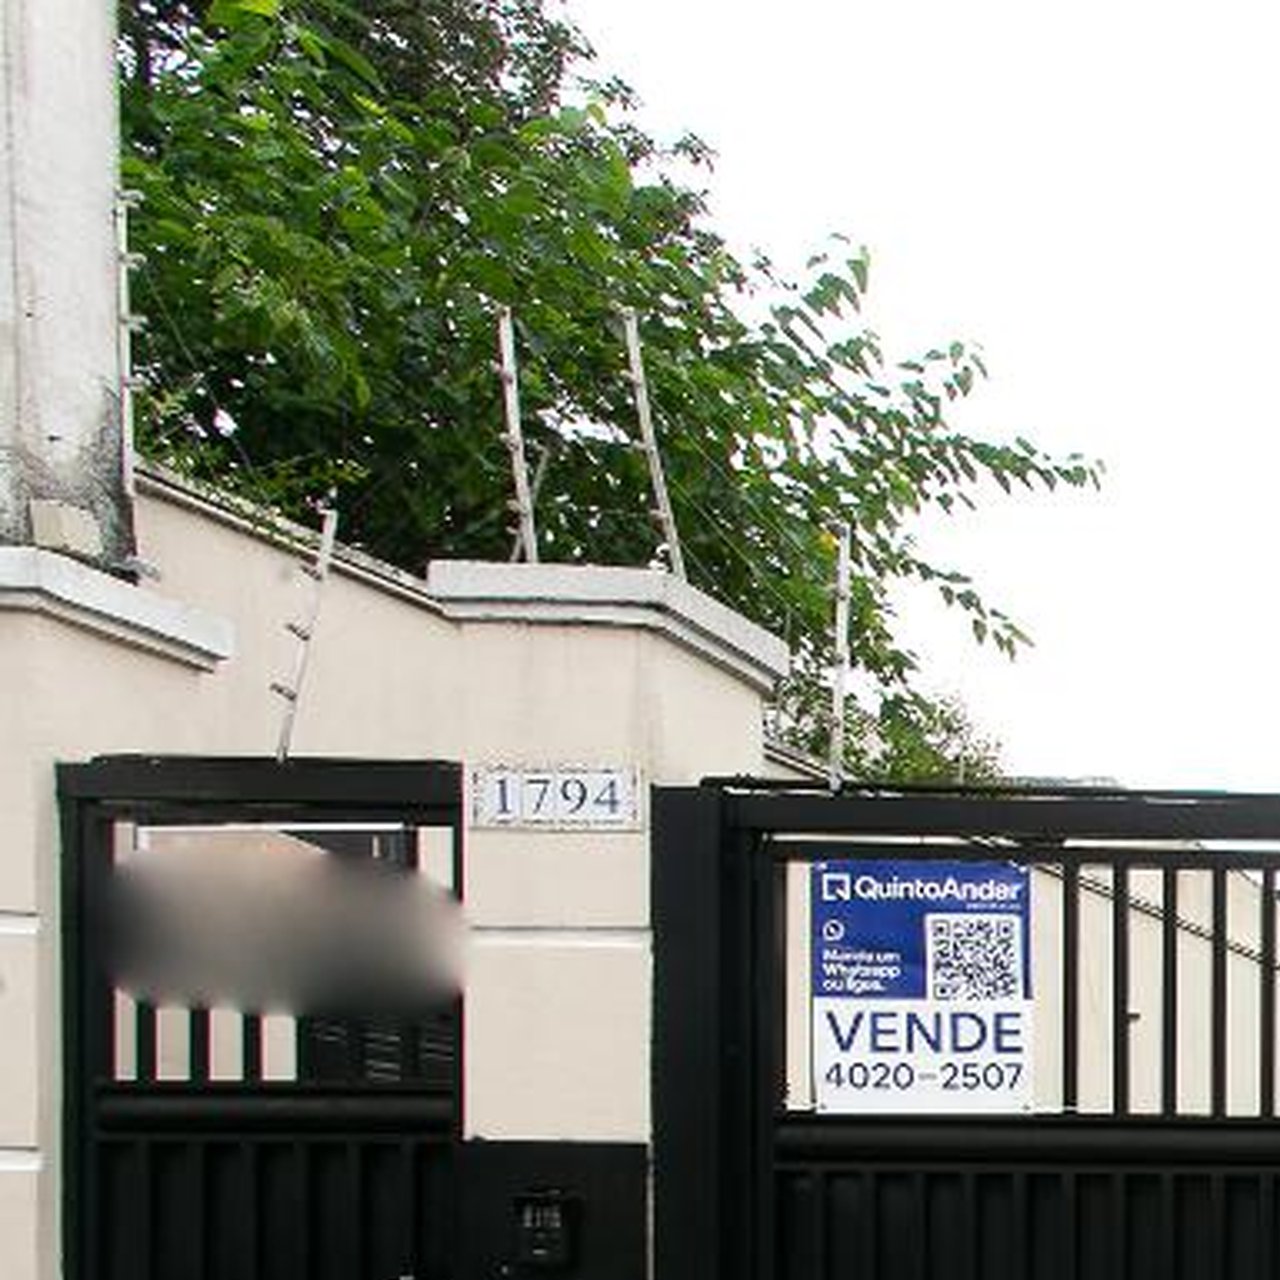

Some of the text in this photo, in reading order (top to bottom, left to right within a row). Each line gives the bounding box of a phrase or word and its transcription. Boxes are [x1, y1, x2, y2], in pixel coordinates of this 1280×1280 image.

[496, 778, 620, 815] 1794
[855, 875, 1023, 900] QuintoAndar
[826, 1012, 1023, 1053] VENDE
[825, 1062, 1023, 1091] 4020-2507
